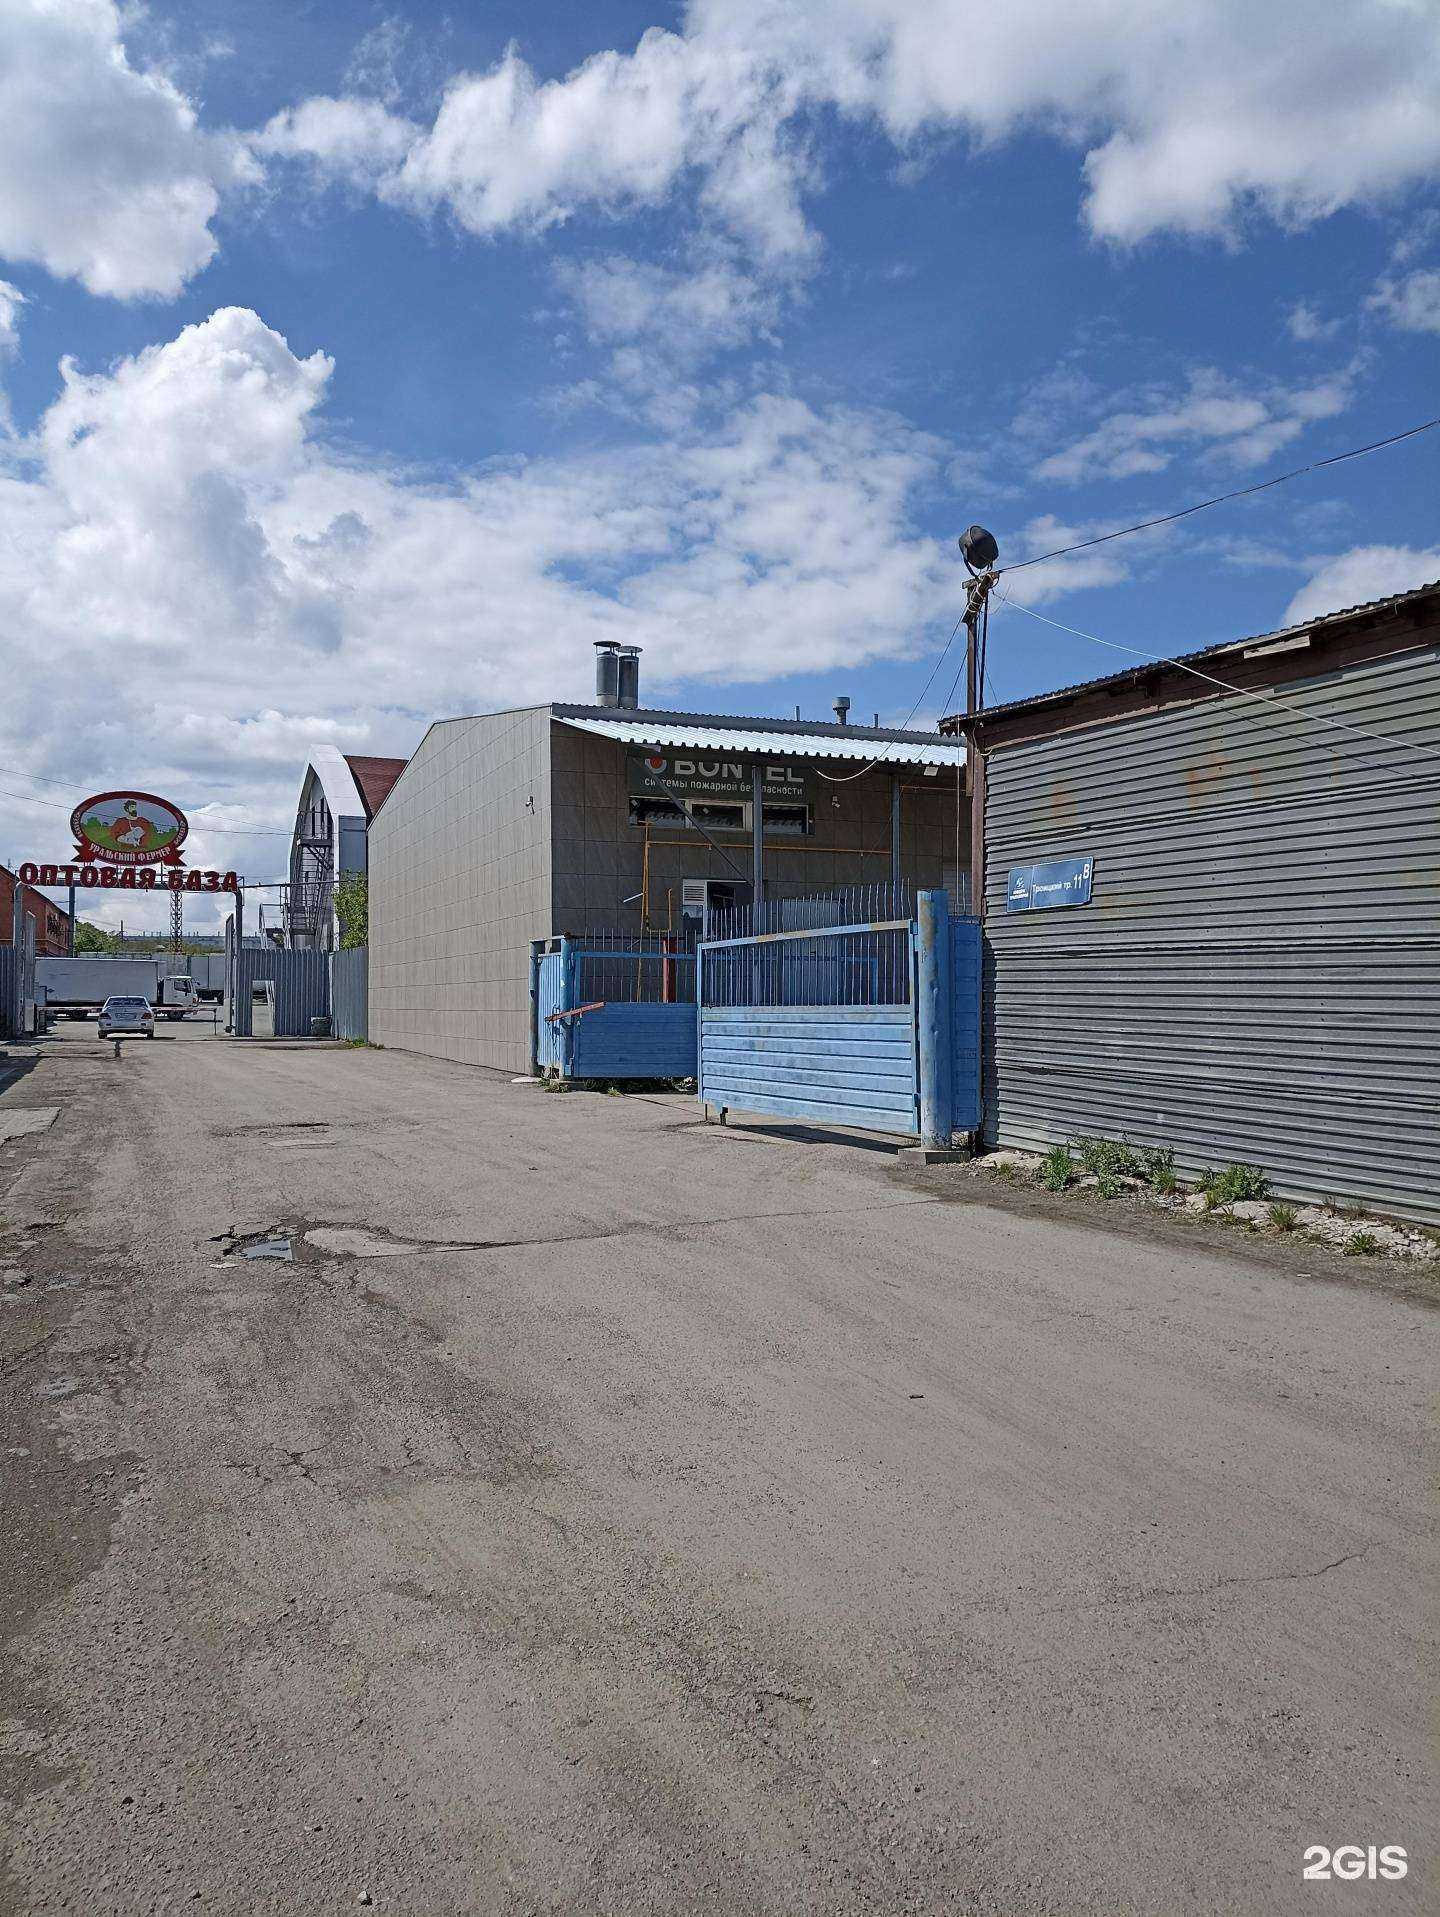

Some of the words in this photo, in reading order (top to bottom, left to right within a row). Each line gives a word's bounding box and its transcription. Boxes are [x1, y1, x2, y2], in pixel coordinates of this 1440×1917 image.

[674, 760, 804, 783] BONEL
[644, 777, 688, 789] ситемы
[690, 780, 738, 793] пожарной
[740, 782, 803, 796] бепасности
[88, 842, 136, 862] УРАЛЬСКИЙ
[138, 846, 171, 861] ФЕРМЕР
[19, 862, 157, 889] ОПТОВАЯ
[167, 870, 238, 893] БАЗА
